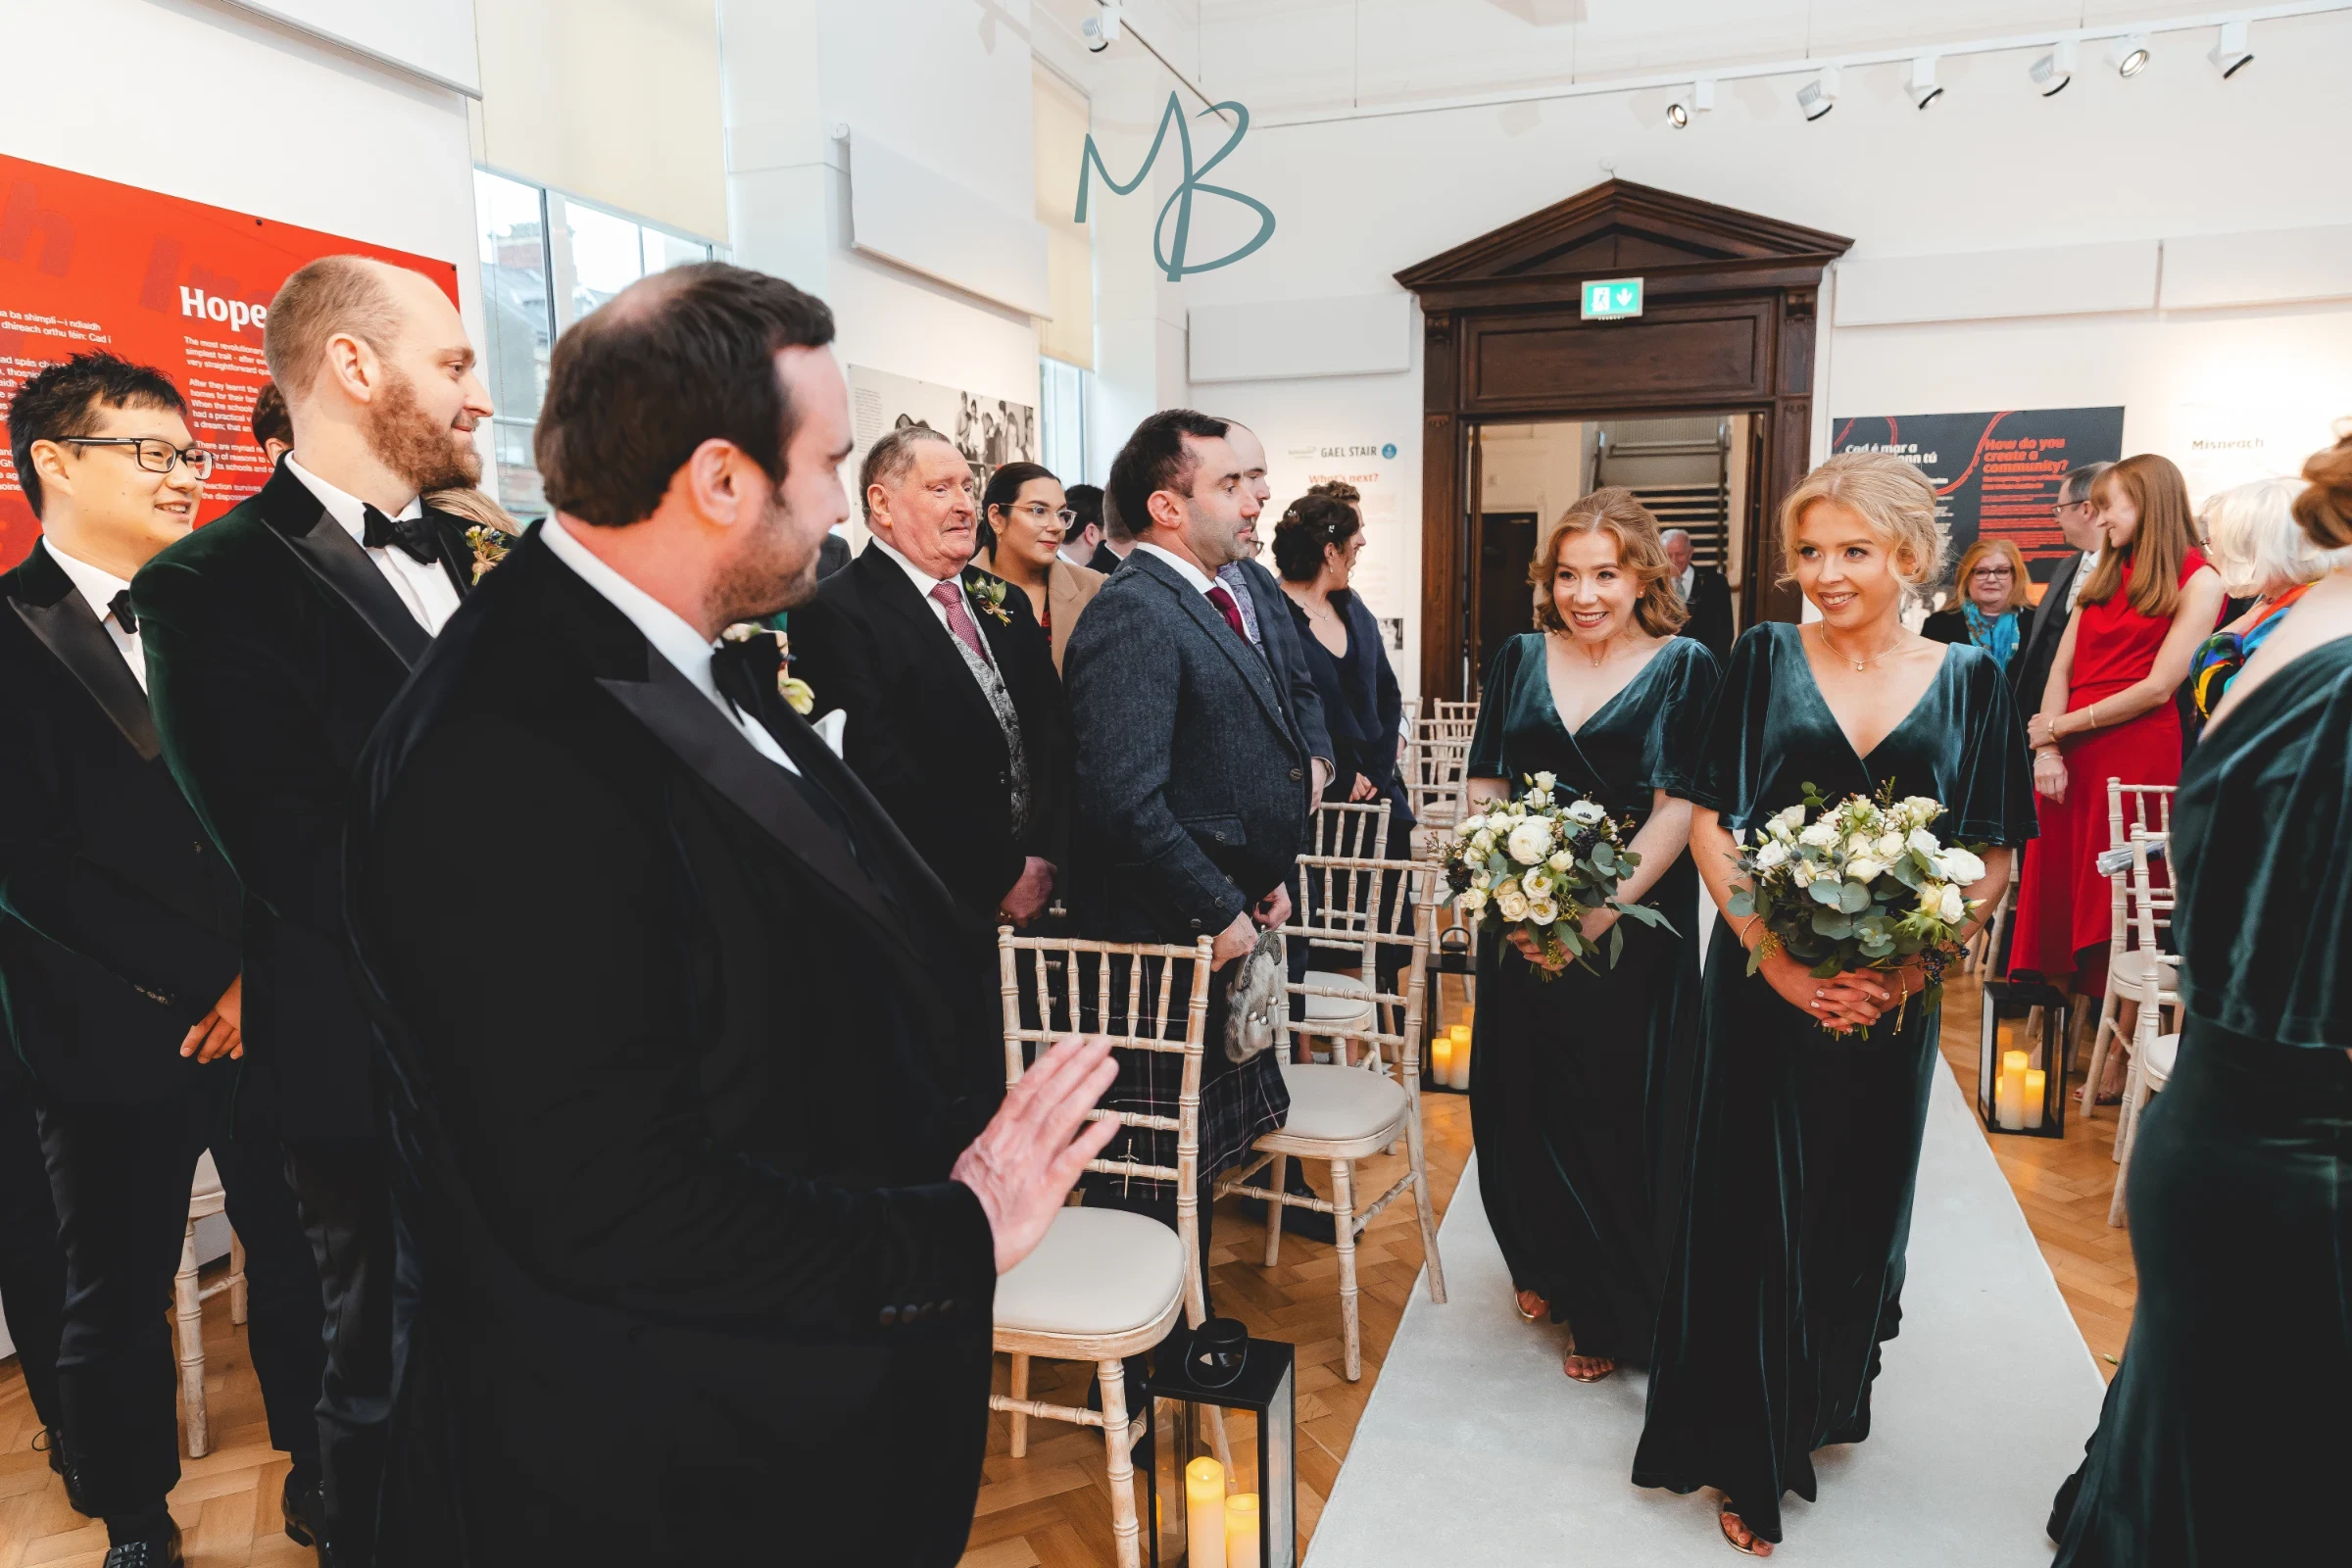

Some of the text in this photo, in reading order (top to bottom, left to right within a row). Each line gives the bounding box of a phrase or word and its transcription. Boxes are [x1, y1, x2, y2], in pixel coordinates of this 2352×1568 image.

[179, 285, 268, 332] Hope
[9, 310, 22, 320] ba
[70, 320, 102, 331] ndiaidh
[43, 327, 67, 338] orthu
[89, 333, 107, 344] Cad
[183, 335, 265, 357] The most revolutionary
[185, 348, 217, 359] simplest
[217, 352, 233, 361] trait
[238, 355, 255, 364] after
[15, 358, 36, 368] spás
[186, 359, 203, 368] very
[204, 361, 258, 374] straightforward
[189, 378, 259, 394] After they learnt the
[189, 389, 216, 399] homes
[227, 393, 244, 402] their
[191, 399, 214, 409] When
[193, 410, 208, 418] had
[215, 413, 246, 422] practical
[226, 423, 241, 432] that
[196, 440, 218, 450] There
[231, 444, 256, 454] myriad
[1880, 443, 1908, 455] mar
[1907, 443, 1919, 454] a
[1984, 436, 2066, 451] How do you
[2191, 437, 2265, 451] Misneach
[229, 454, 258, 464] reasons
[1320, 447, 1347, 459] GAEL
[1348, 446, 1377, 458] STAIR
[1922, 451, 1938, 465] tú
[1983, 450, 2039, 463] create a
[225, 464, 253, 473] schools
[1982, 459, 2070, 474] community?
[1348, 473, 1380, 484] next?
[202, 482, 233, 491] Reaction
